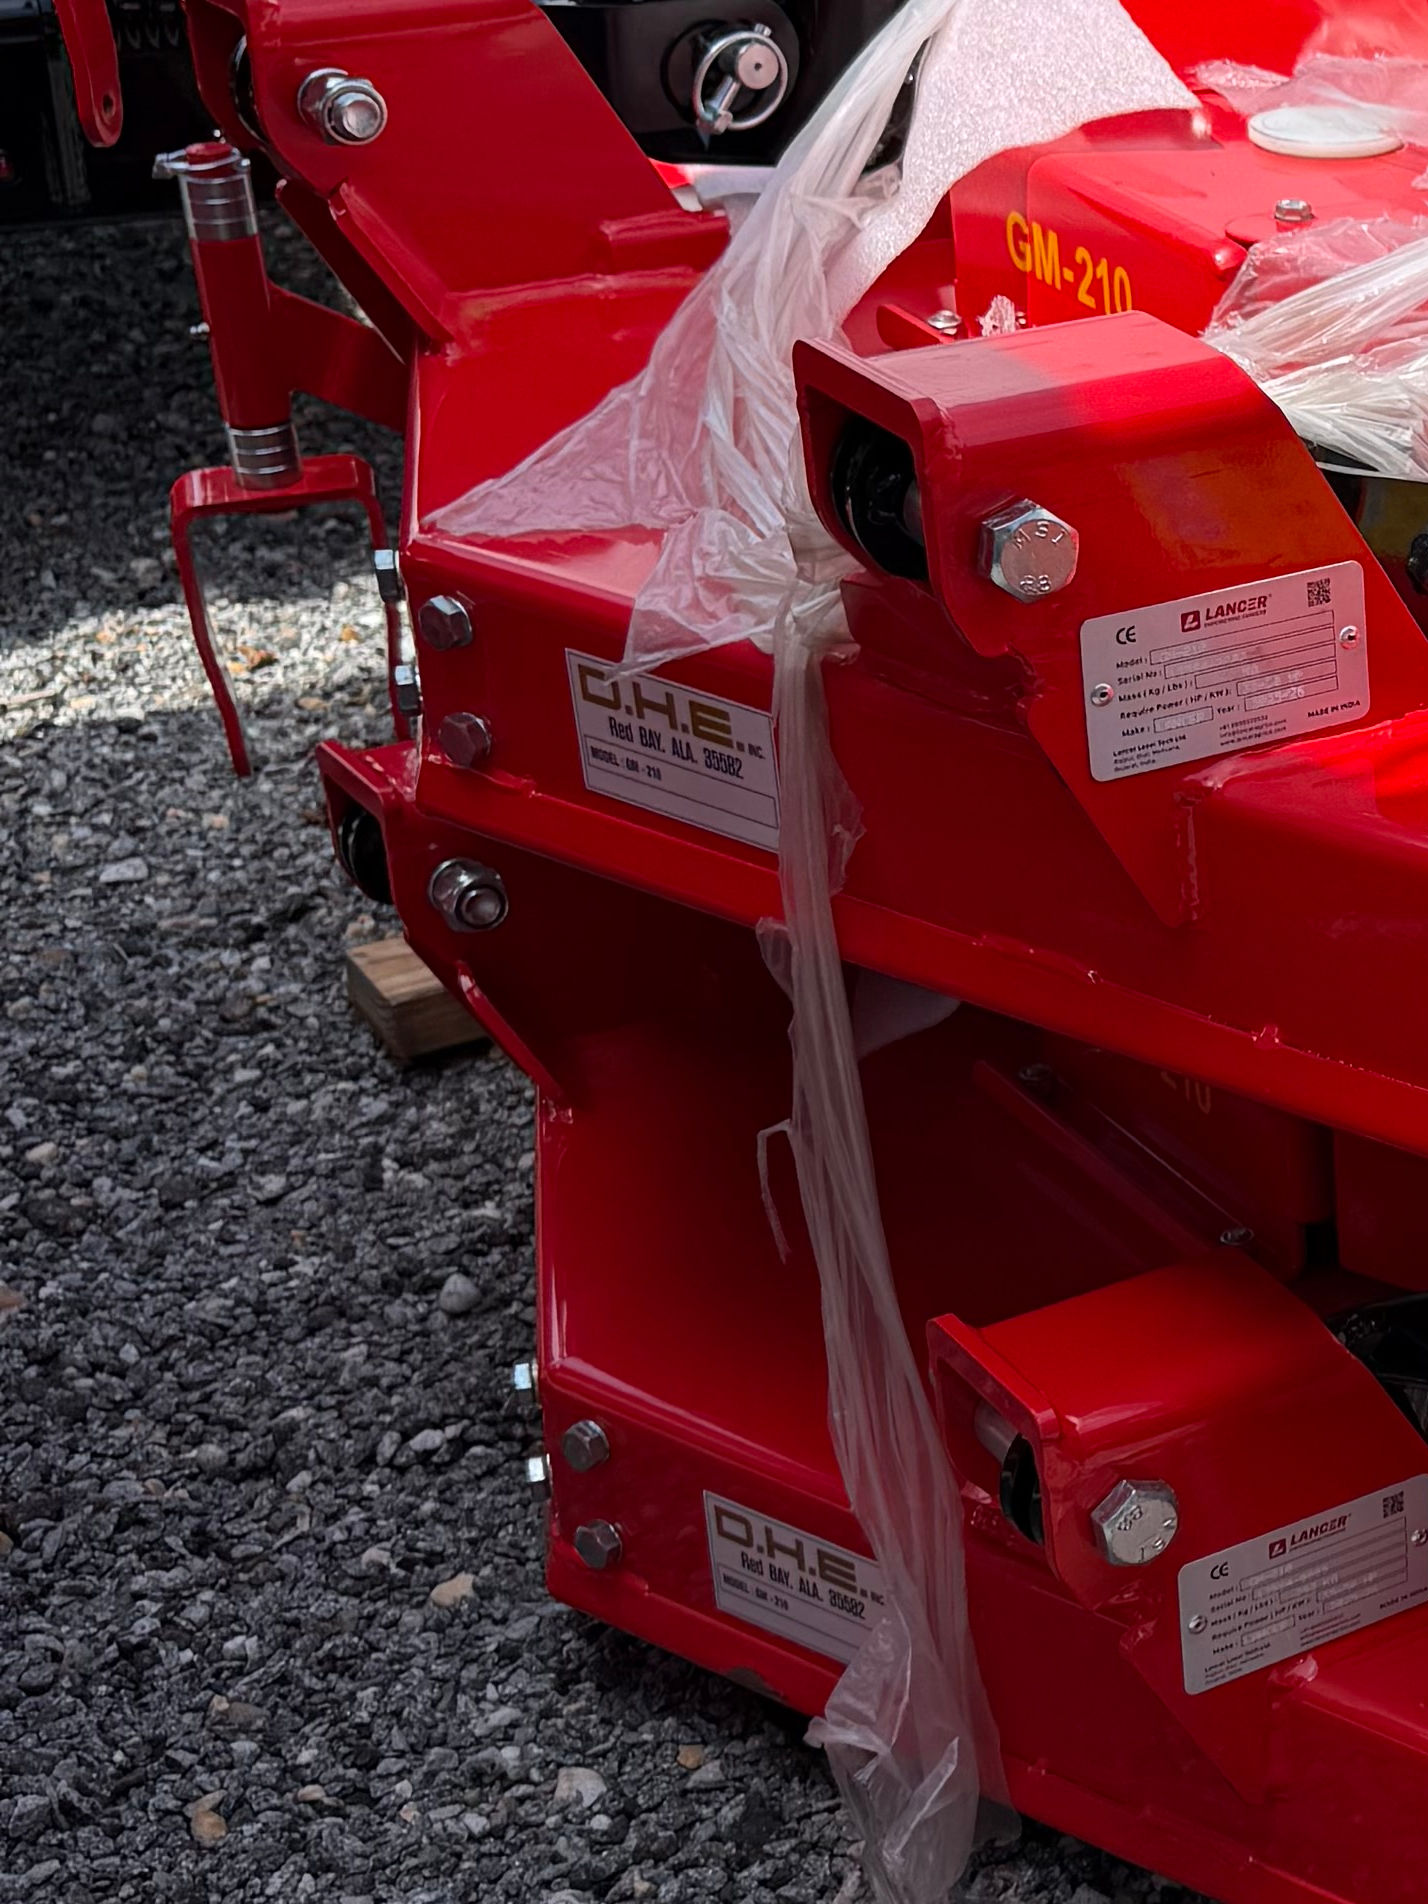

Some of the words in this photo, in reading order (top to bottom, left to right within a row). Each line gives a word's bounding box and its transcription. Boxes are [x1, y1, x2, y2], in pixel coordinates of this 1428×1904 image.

[1006, 210, 1133, 315] GM-210
[1205, 595, 1269, 621] LANCER
[608, 716, 634, 743] Red
